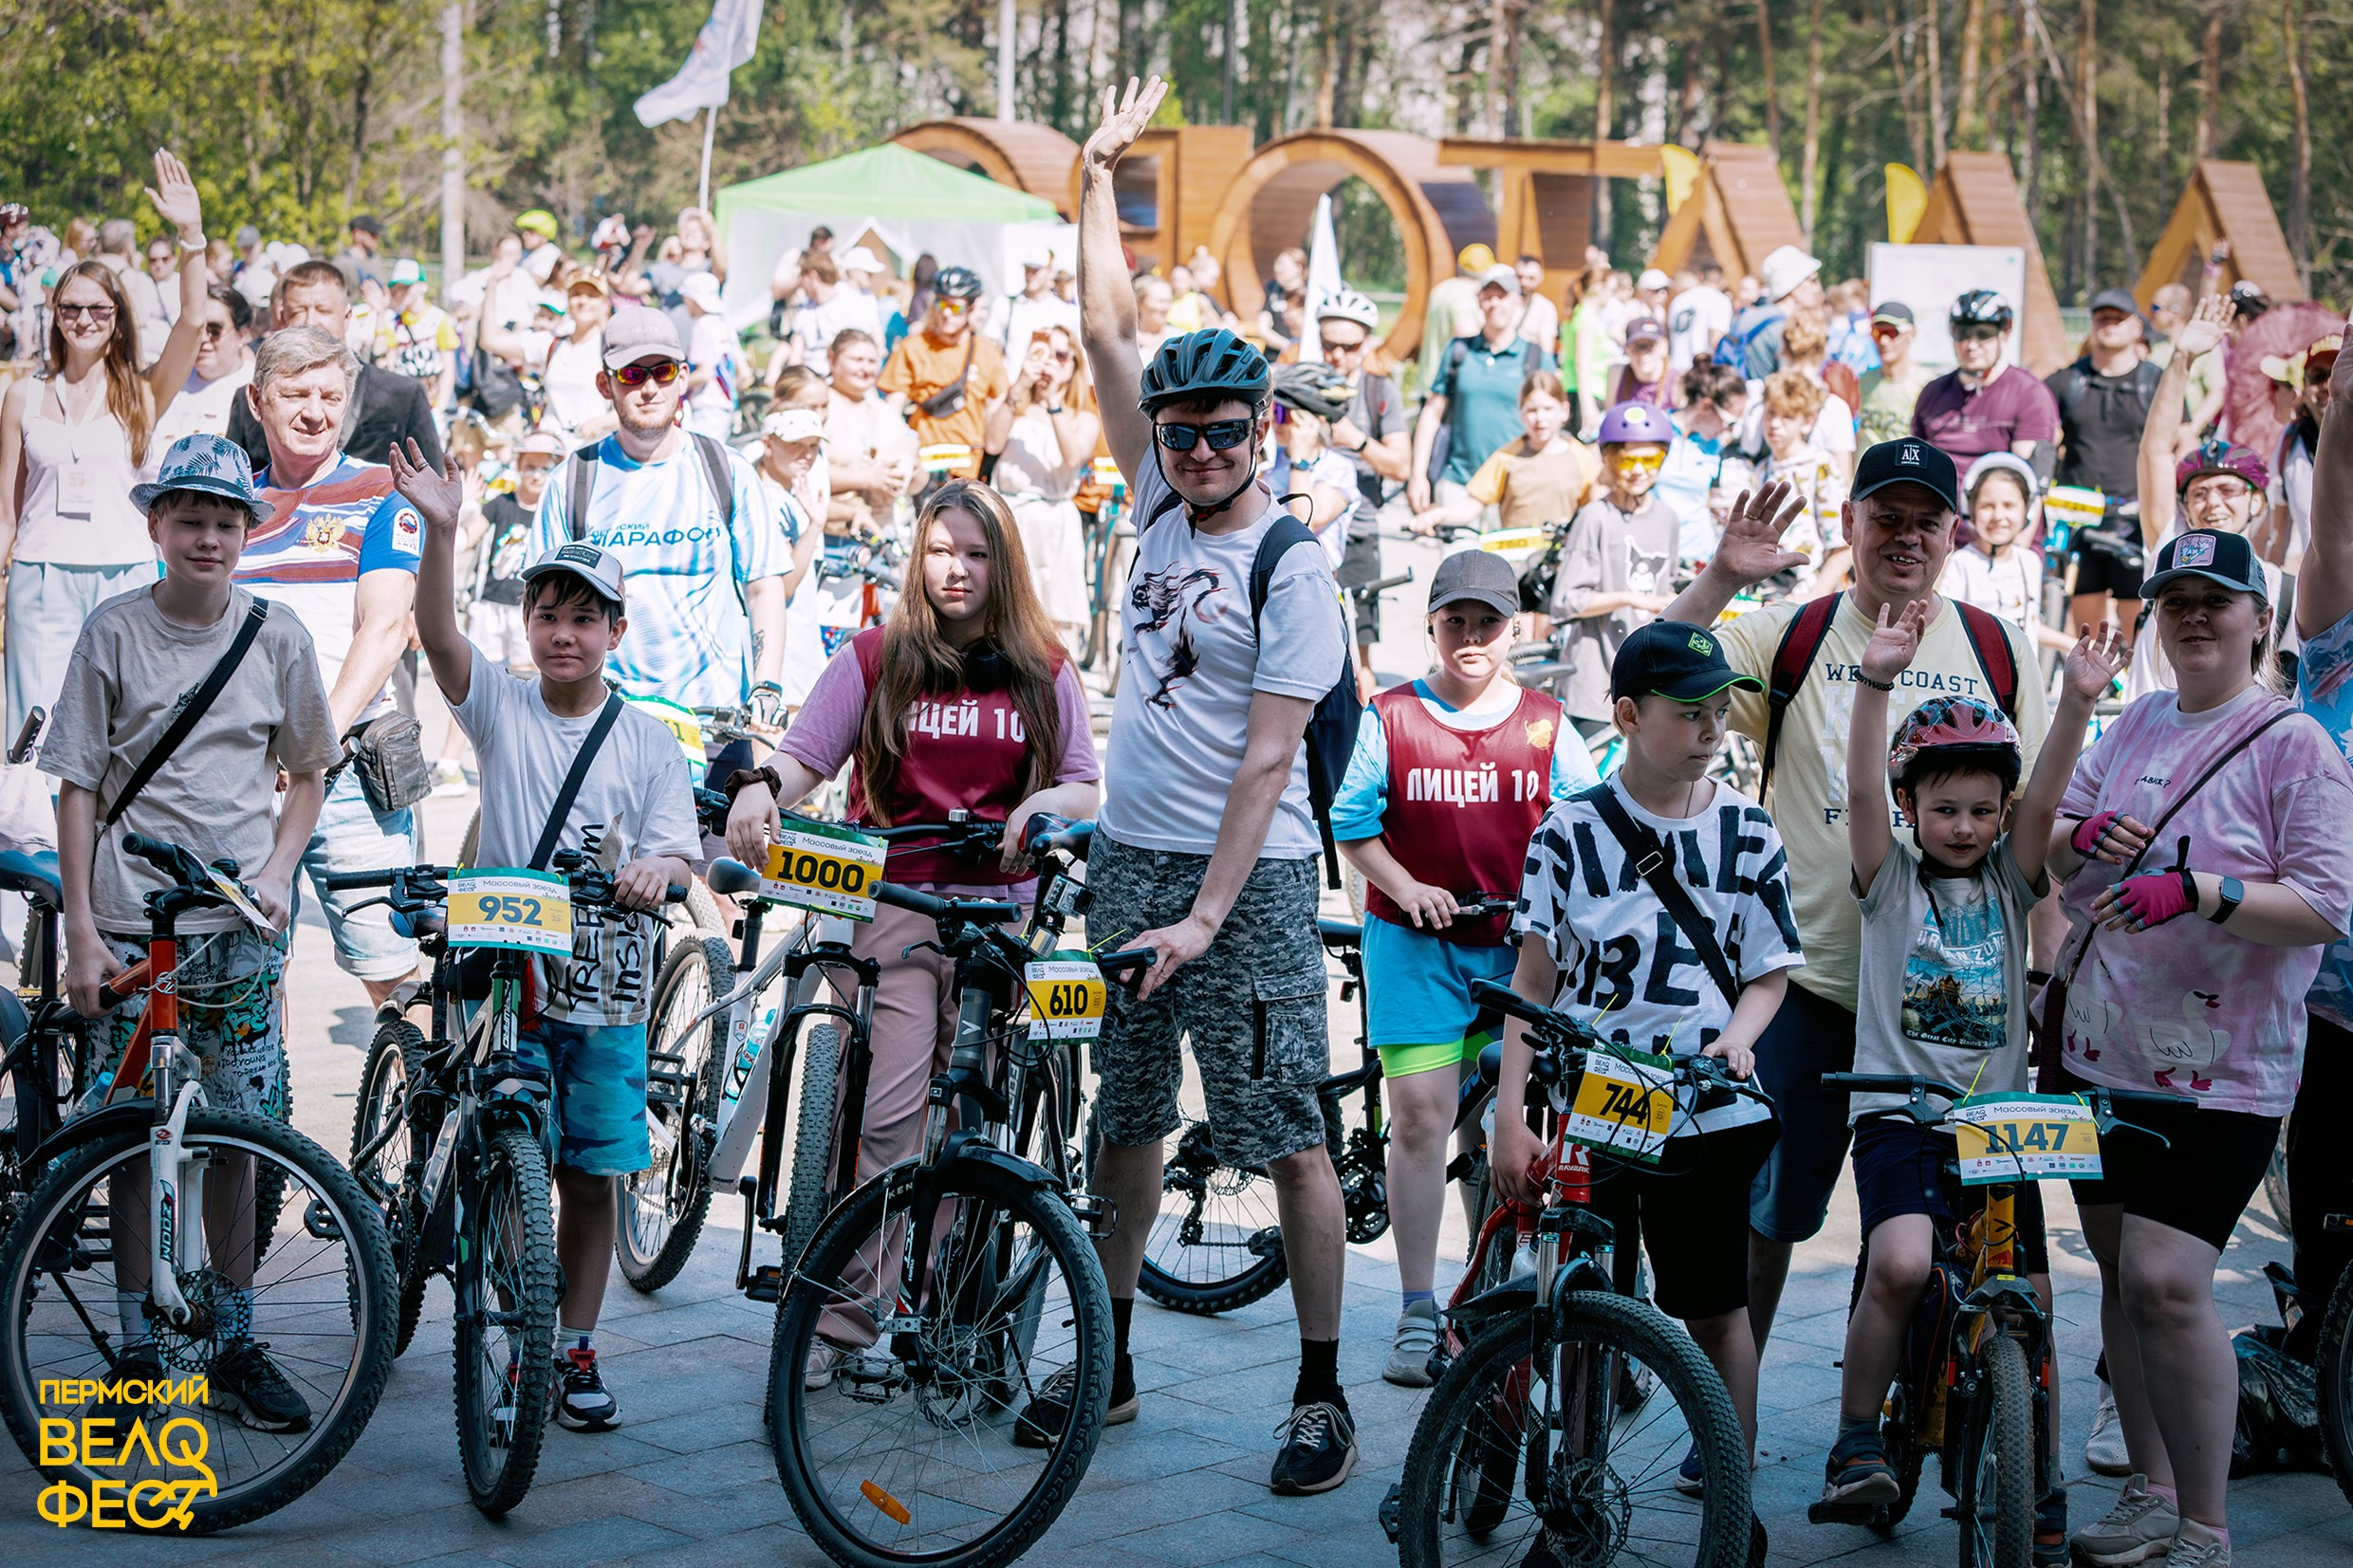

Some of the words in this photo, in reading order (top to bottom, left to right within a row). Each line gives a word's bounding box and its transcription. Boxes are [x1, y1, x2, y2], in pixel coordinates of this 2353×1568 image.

[1900, 670, 1978, 694] COAST
[994, 708, 1026, 744] 10
[1407, 762, 1499, 808] ЛИЦЕЙ
[1511, 769, 1540, 802] 10
[802, 837, 846, 852] Массовый
[483, 879, 530, 888] Массовый
[777, 851, 864, 893] 1000
[478, 895, 543, 927] 952
[1049, 984, 1088, 1017] 610
[1599, 1082, 1649, 1125] 744
[1993, 1106, 2047, 1115] Массовый
[1984, 1123, 2069, 1153] 1147
[160, 1202, 174, 1263] ZOOM
